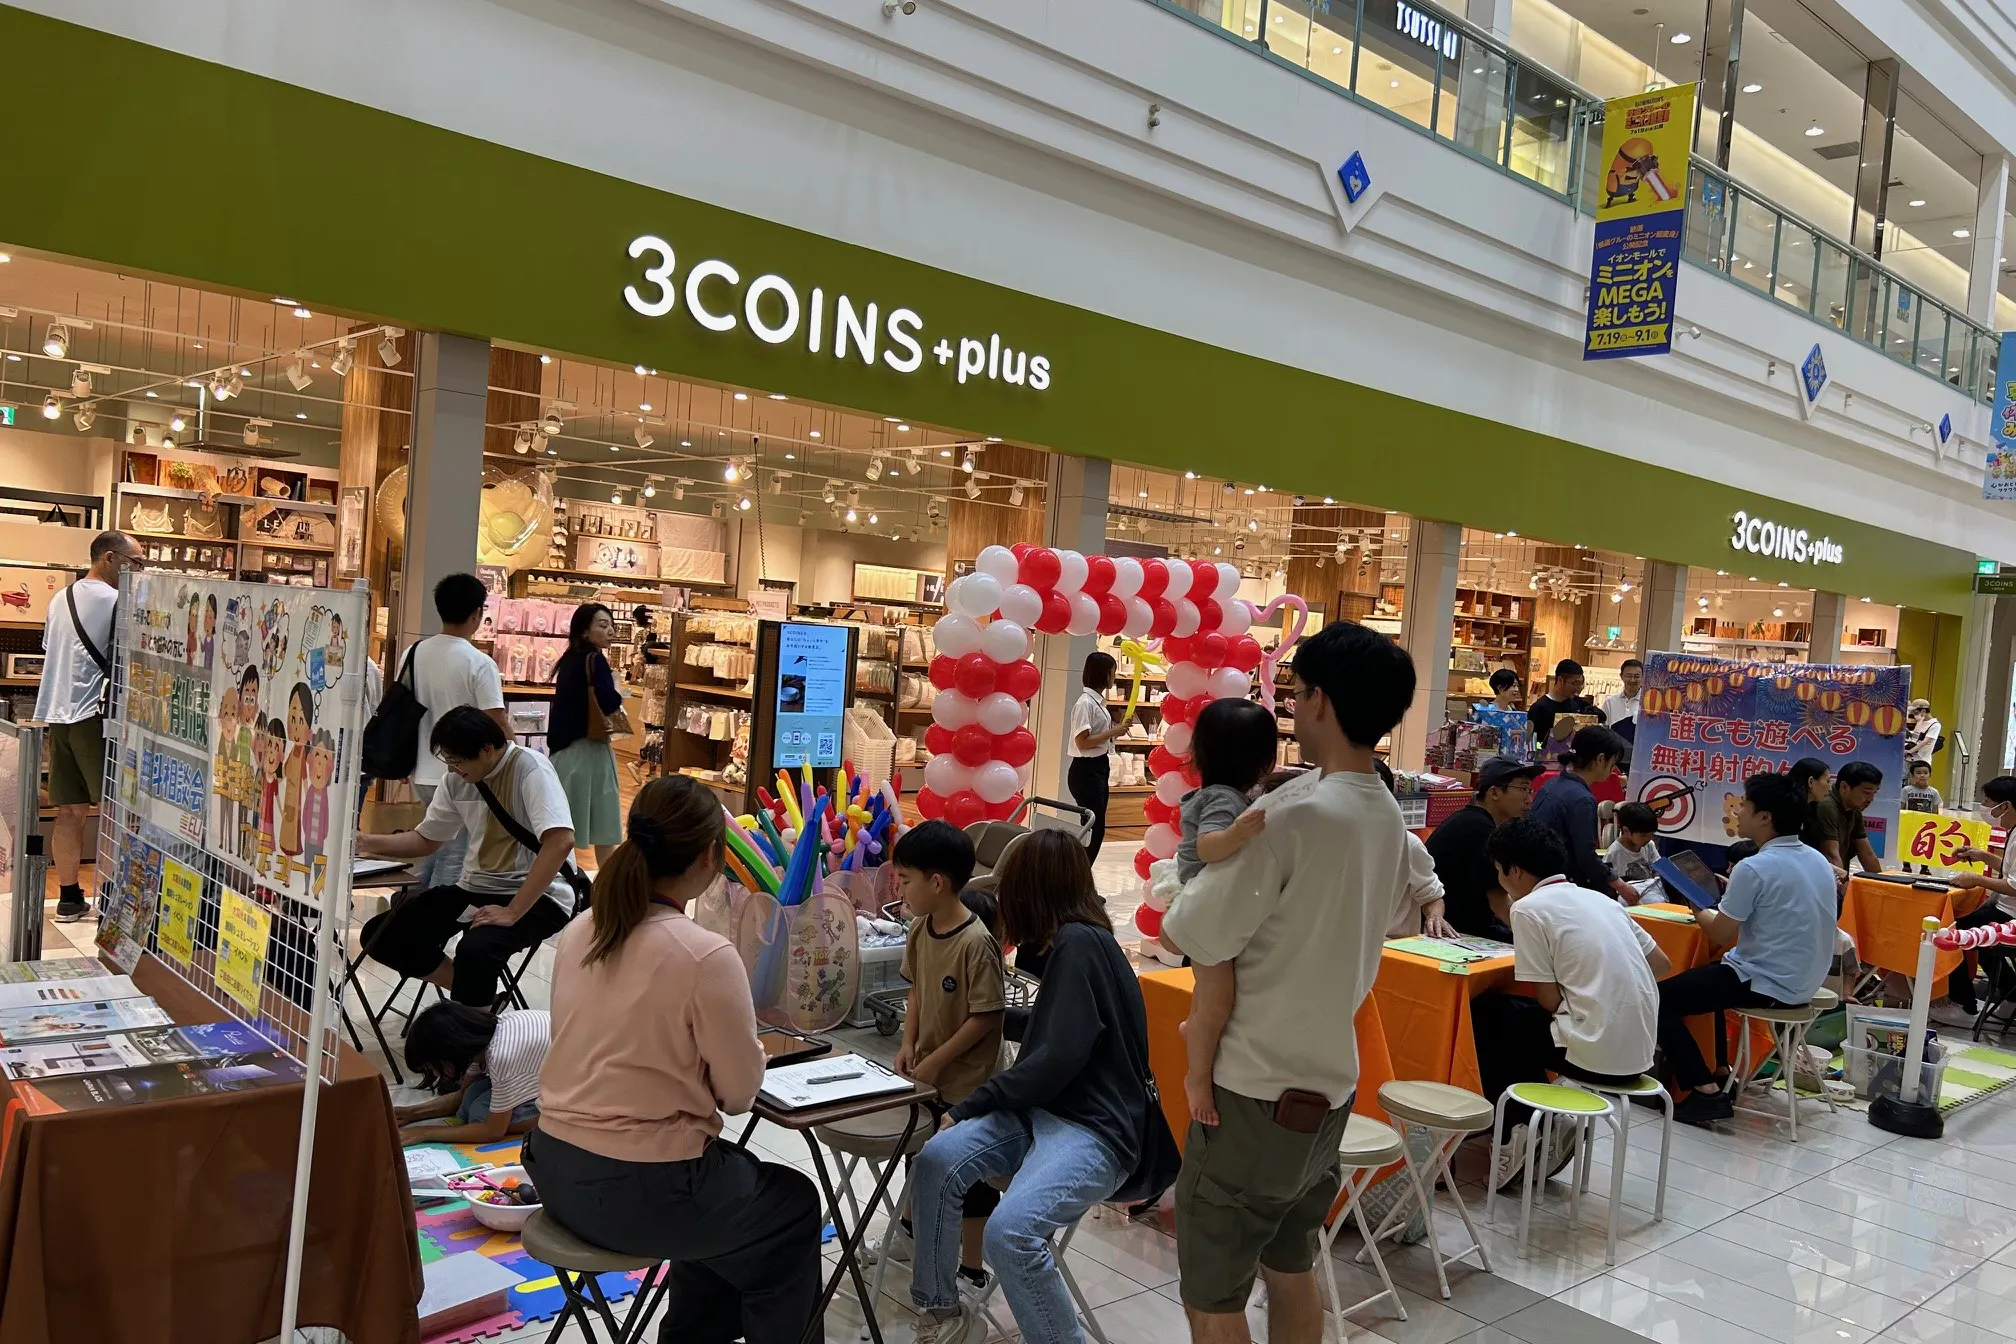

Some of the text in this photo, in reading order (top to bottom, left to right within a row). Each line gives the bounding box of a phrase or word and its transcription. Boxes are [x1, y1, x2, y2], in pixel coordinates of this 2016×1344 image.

[1608, 248, 1667, 263] イオンモールで
[1597, 259, 1674, 284] ミニオンを
[1598, 281, 1663, 306] MEGA
[1984, 580, 2014, 588] 3COINS
[1669, 709, 1858, 755] 誰でも遊べる
[140, 747, 205, 814] 無料相談会
[1910, 820, 1971, 867] 的
